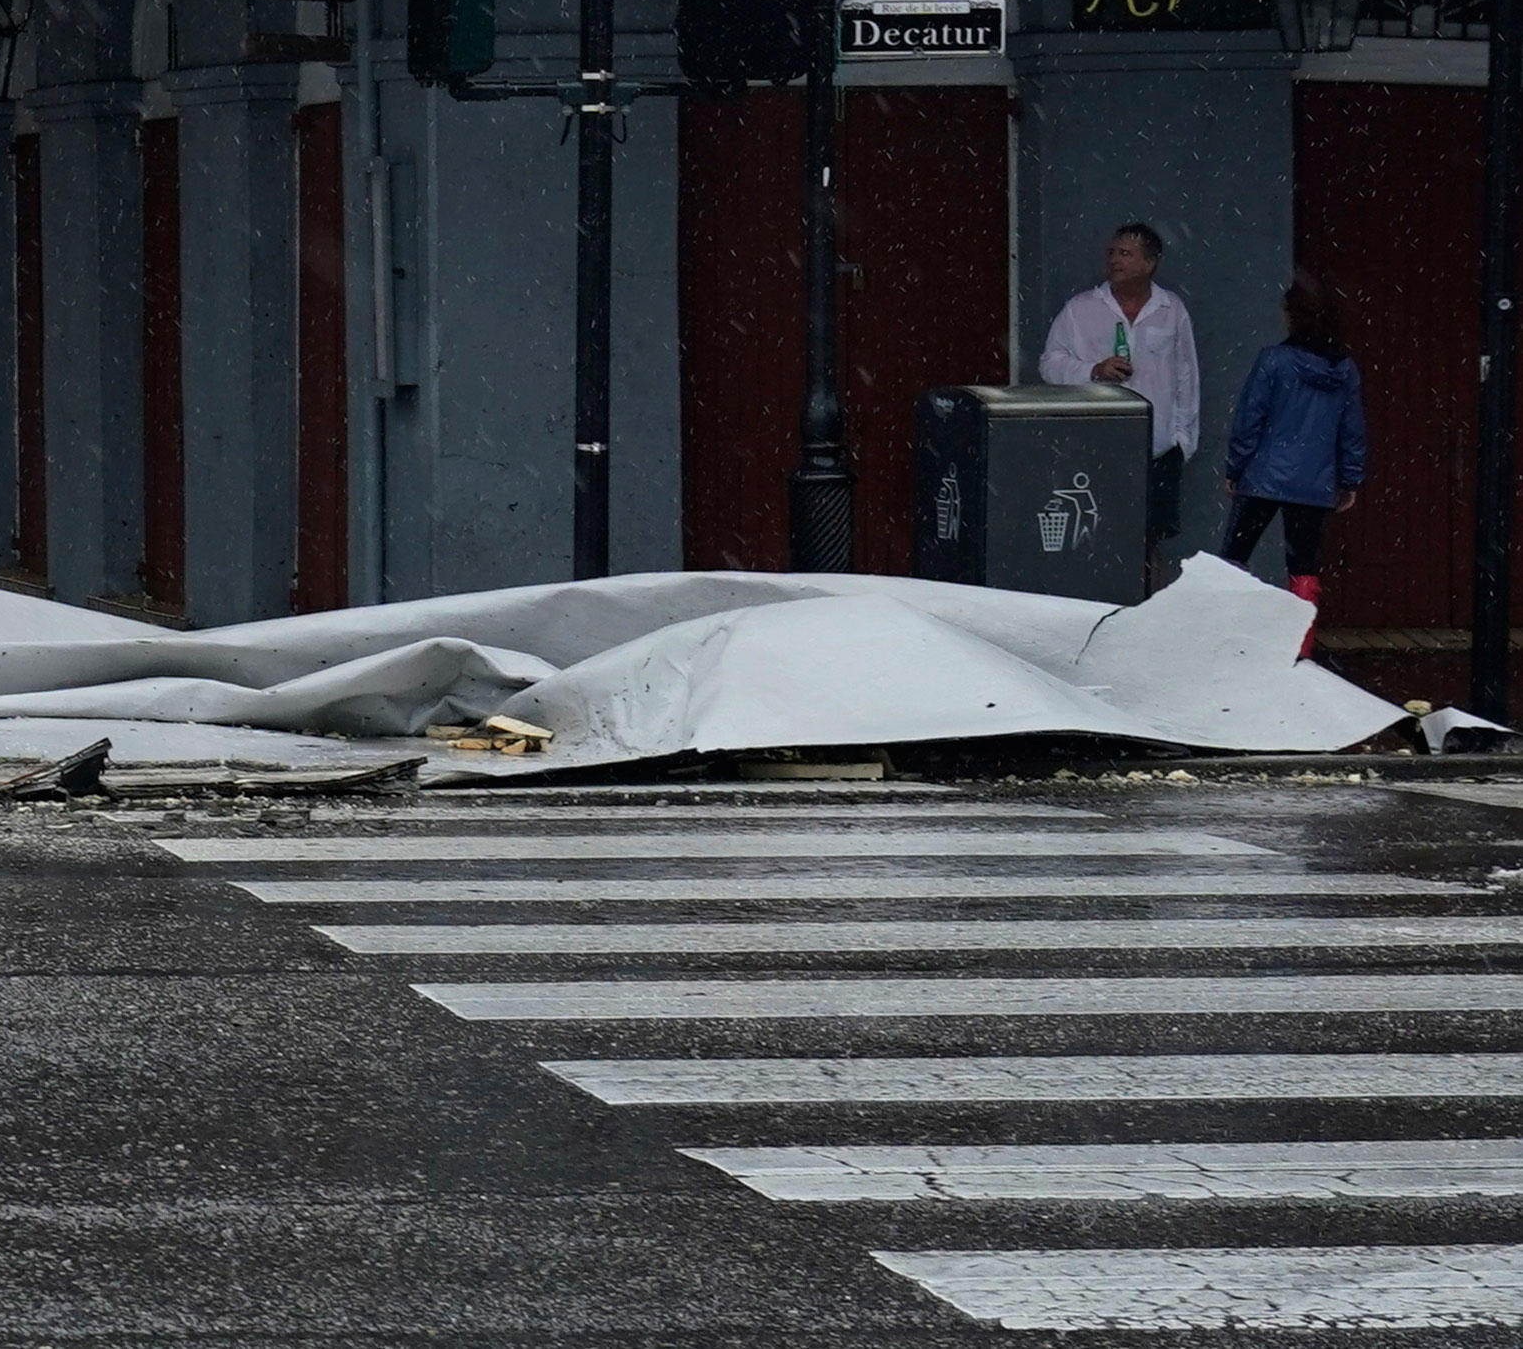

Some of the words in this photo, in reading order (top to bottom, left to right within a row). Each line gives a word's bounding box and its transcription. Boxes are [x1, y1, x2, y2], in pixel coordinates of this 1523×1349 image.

[881, 3, 903, 13] Rue
[905, 3, 919, 13] de
[851, 19, 992, 47] Decatur
